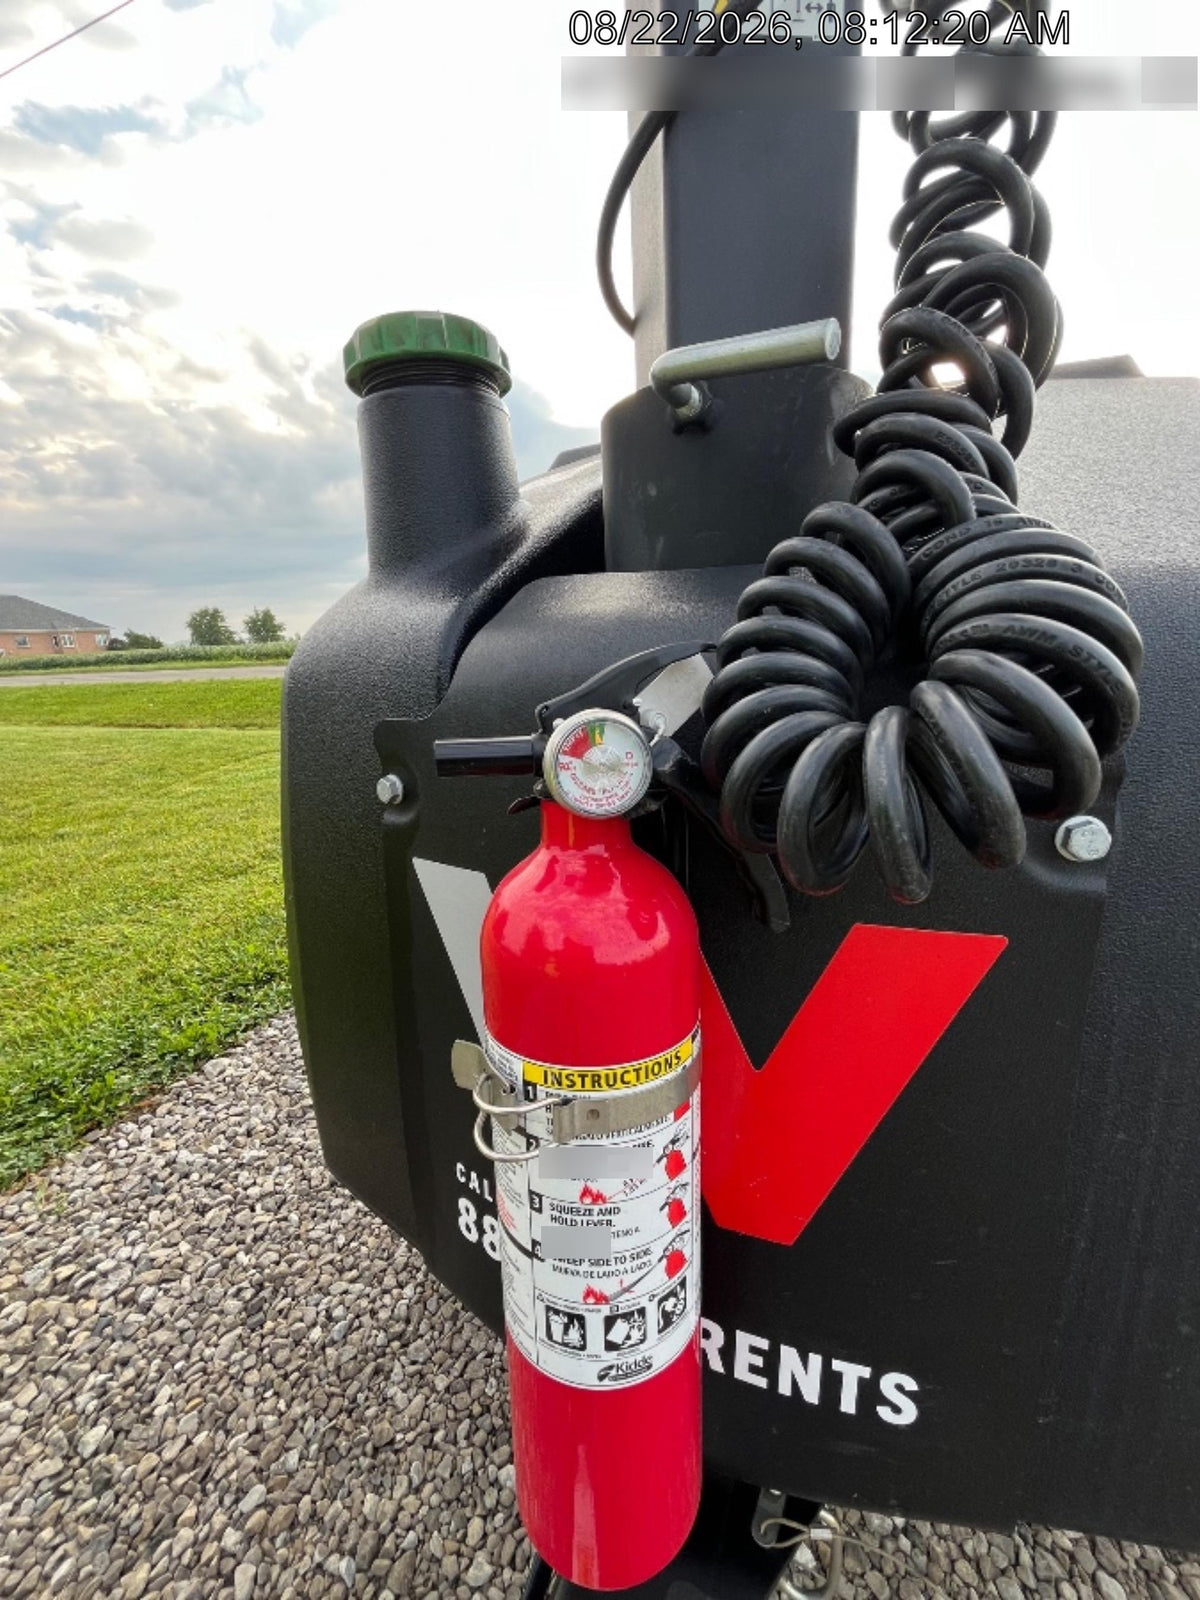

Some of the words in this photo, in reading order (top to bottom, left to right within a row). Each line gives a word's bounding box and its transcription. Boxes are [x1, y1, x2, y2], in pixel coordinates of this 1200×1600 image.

[543, 1050, 683, 1090] INSTRUCTIONS
[526, 1086, 534, 1100] 1
[533, 1197, 540, 1208] 3
[549, 1202, 594, 1217] SQUEEZE
[596, 1206, 622, 1217] AND
[550, 1214, 579, 1227] HOLD
[458, 1197, 501, 1261] 88
[614, 1254, 627, 1266] TO
[700, 1317, 920, 1426] RENTS
